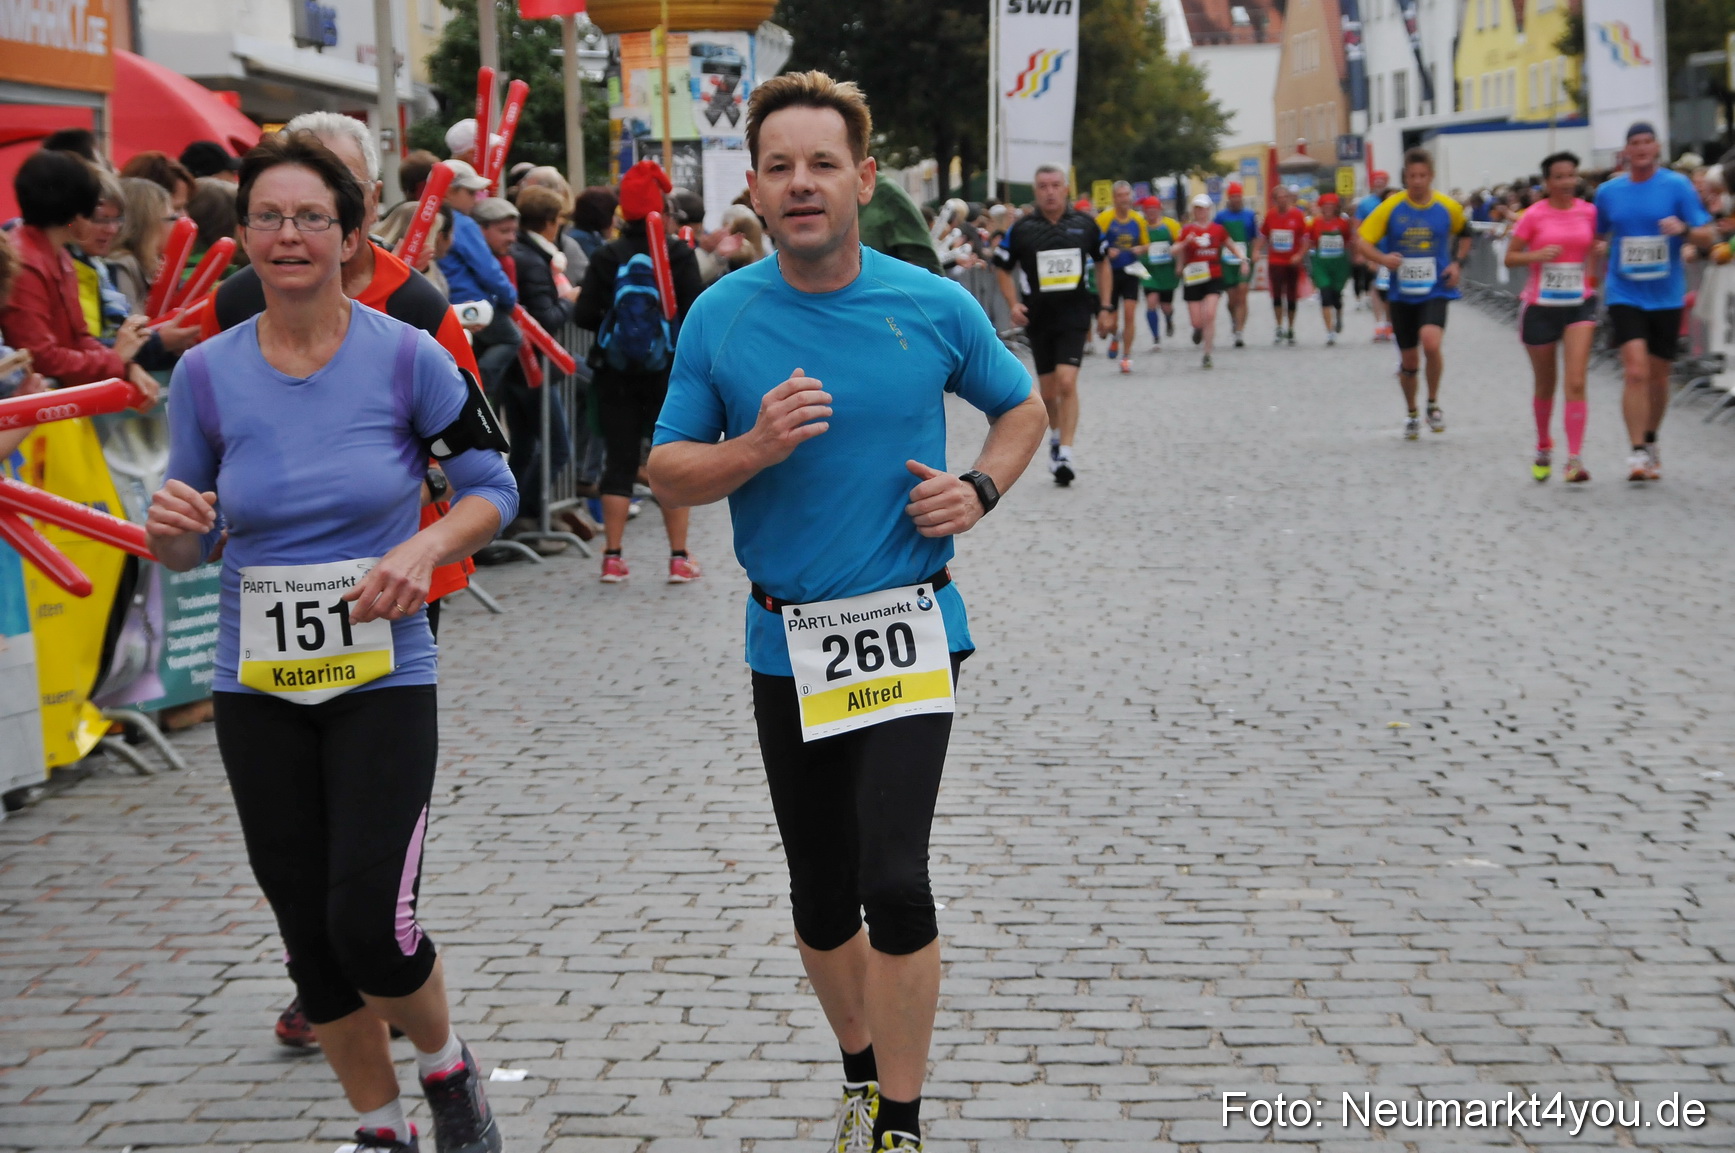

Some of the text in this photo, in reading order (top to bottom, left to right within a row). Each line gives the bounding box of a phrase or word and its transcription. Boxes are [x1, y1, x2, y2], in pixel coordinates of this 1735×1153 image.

[1006, 0, 1072, 14] swn
[243, 575, 356, 594] PARTL Neumarkt
[265, 597, 354, 652] 151
[788, 601, 912, 632] PARTL Neumarkt
[245, 650, 250, 659] D
[822, 621, 917, 682] 260
[272, 663, 356, 687] Katarina
[802, 685, 809, 695] D
[847, 681, 903, 712] Alfred
